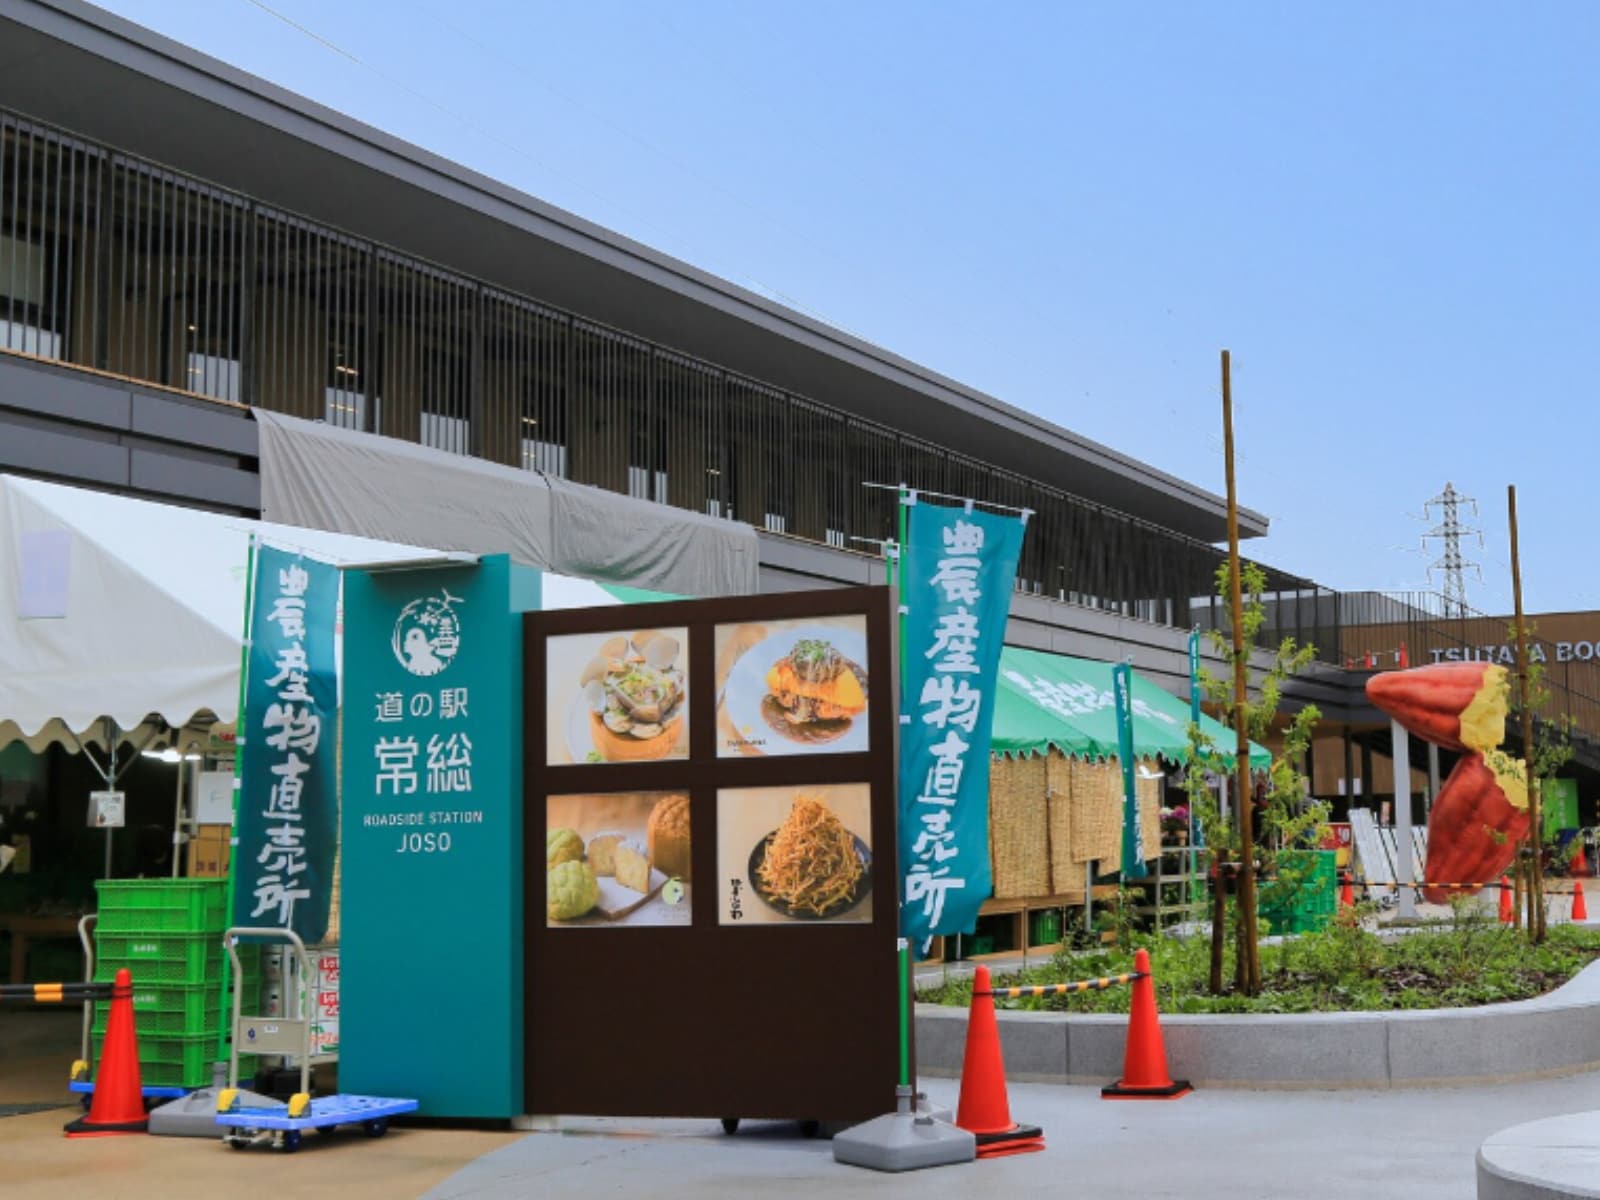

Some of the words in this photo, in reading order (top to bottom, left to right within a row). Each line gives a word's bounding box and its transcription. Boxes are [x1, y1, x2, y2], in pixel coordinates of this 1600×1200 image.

[1429, 643, 1546, 664] TSUTAA
[1556, 640, 1600, 662] BO
[374, 687, 469, 723] 道の駅
[250, 563, 321, 927] 農産物直売所
[904, 519, 985, 952] 農産物直売所
[374, 732, 473, 795] 常総
[363, 813, 426, 827] ROADSIDE
[429, 810, 483, 825] STATION
[396, 832, 452, 853] JOSO
